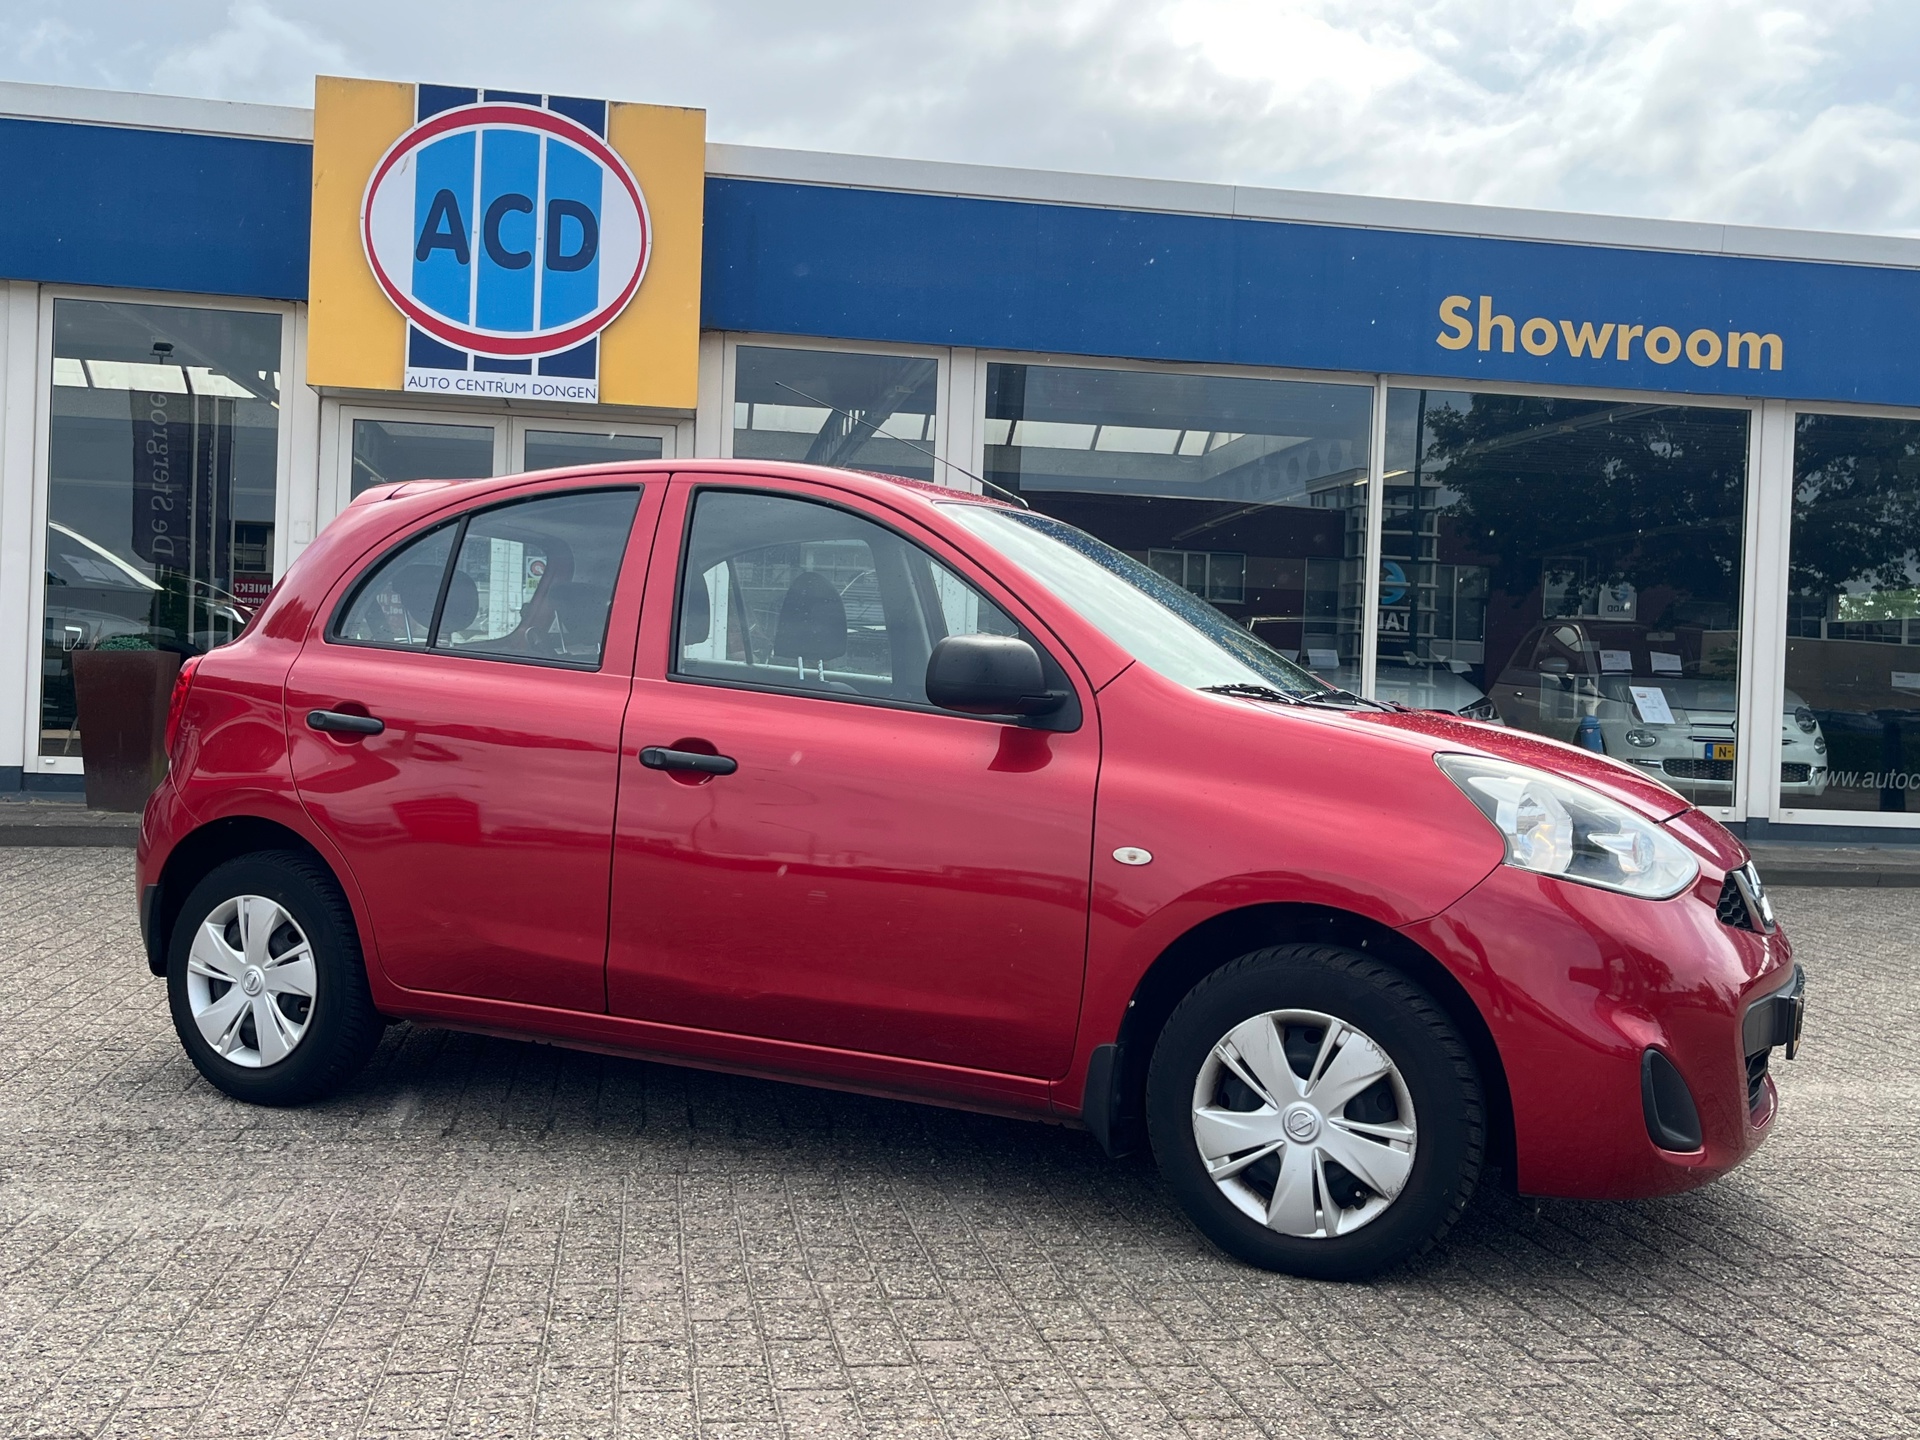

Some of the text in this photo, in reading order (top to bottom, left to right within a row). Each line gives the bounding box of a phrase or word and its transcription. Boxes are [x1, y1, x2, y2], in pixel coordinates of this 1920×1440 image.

[415, 188, 599, 272] ACD
[1436, 295, 1784, 371] Showroom
[407, 376, 597, 399] AUTO CENTRUM DONGEN
